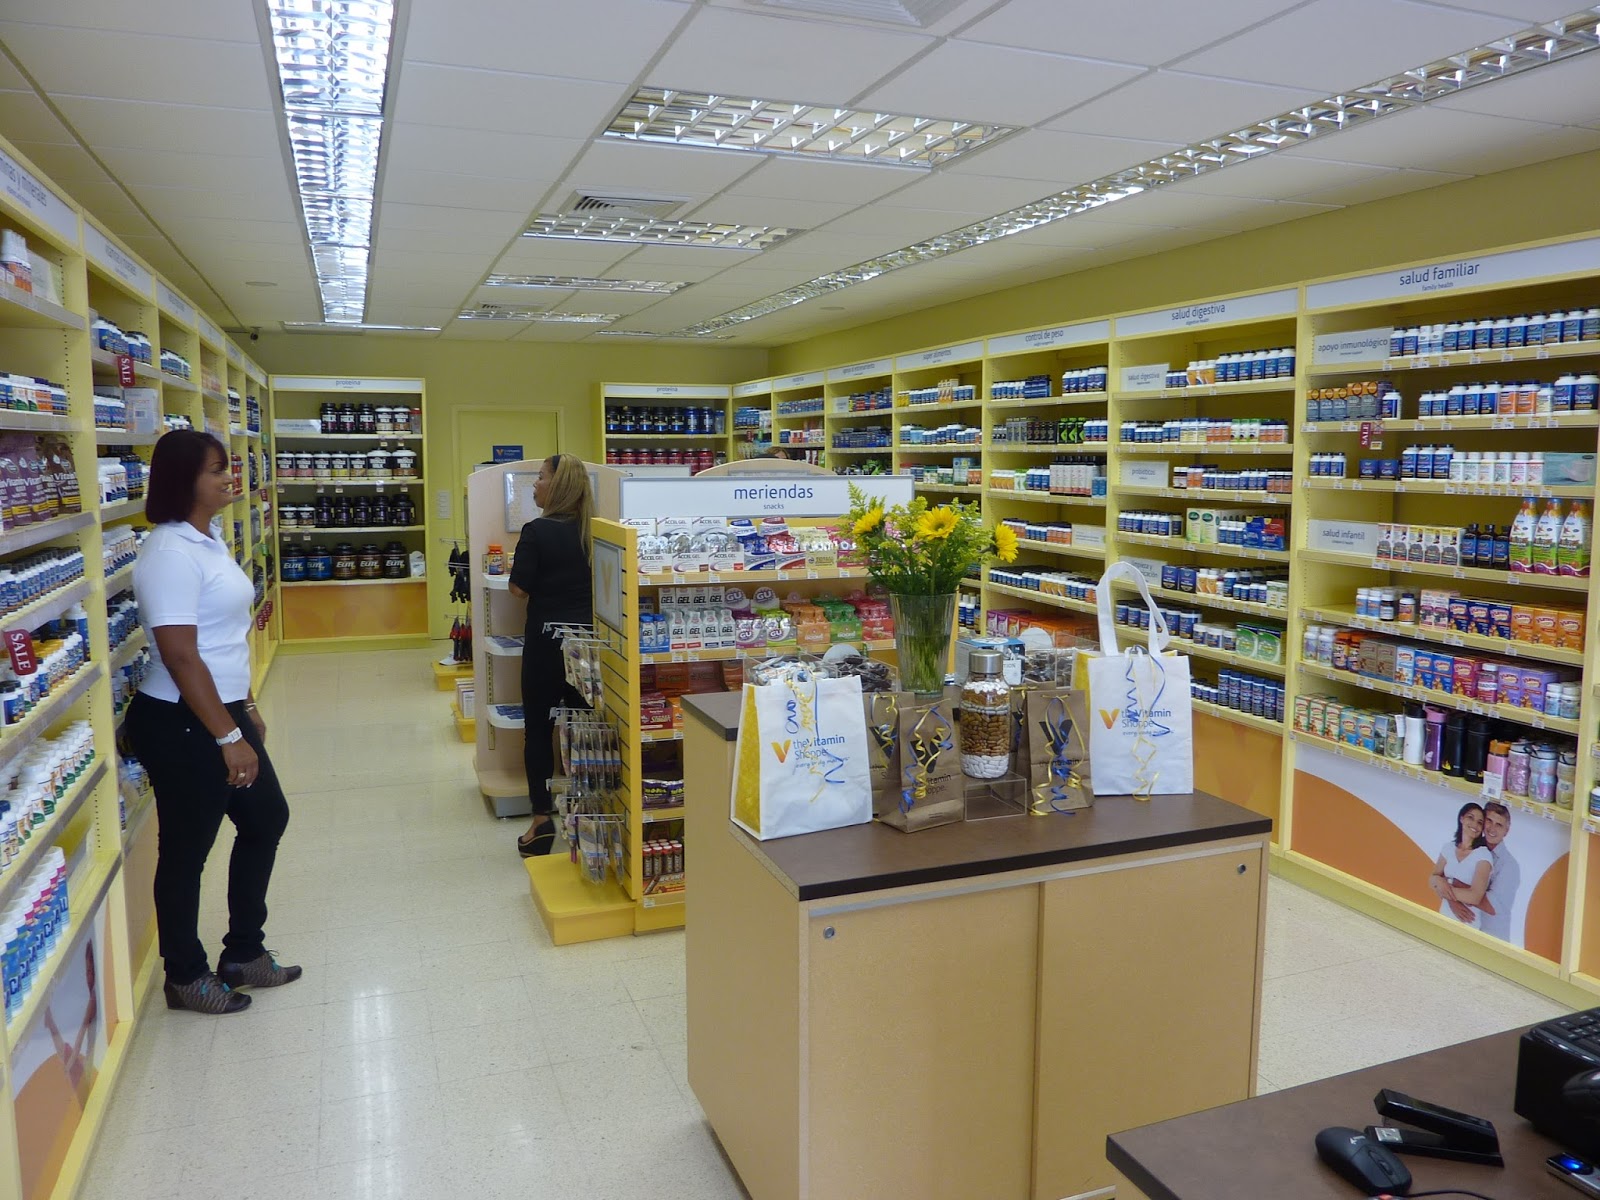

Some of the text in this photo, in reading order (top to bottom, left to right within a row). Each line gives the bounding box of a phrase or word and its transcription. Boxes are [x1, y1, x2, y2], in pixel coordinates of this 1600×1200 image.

[1399, 262, 1480, 286] salud familiar
[1171, 303, 1226, 321] salud digestiva
[1025, 329, 1064, 343] control de peso
[1318, 335, 1388, 352] apoyo inmunológico
[120, 357, 132, 384] SALE
[733, 483, 814, 499] meriendas
[763, 502, 784, 510] snacks
[1322, 529, 1365, 540] salud infantil
[661, 596, 674, 604] GEL
[677, 596, 691, 604] GEL
[693, 596, 707, 604] GEL
[709, 595, 723, 603] GEL
[726, 591, 742, 601] GU
[756, 590, 772, 600] GU
[10, 633, 31, 671] SALE
